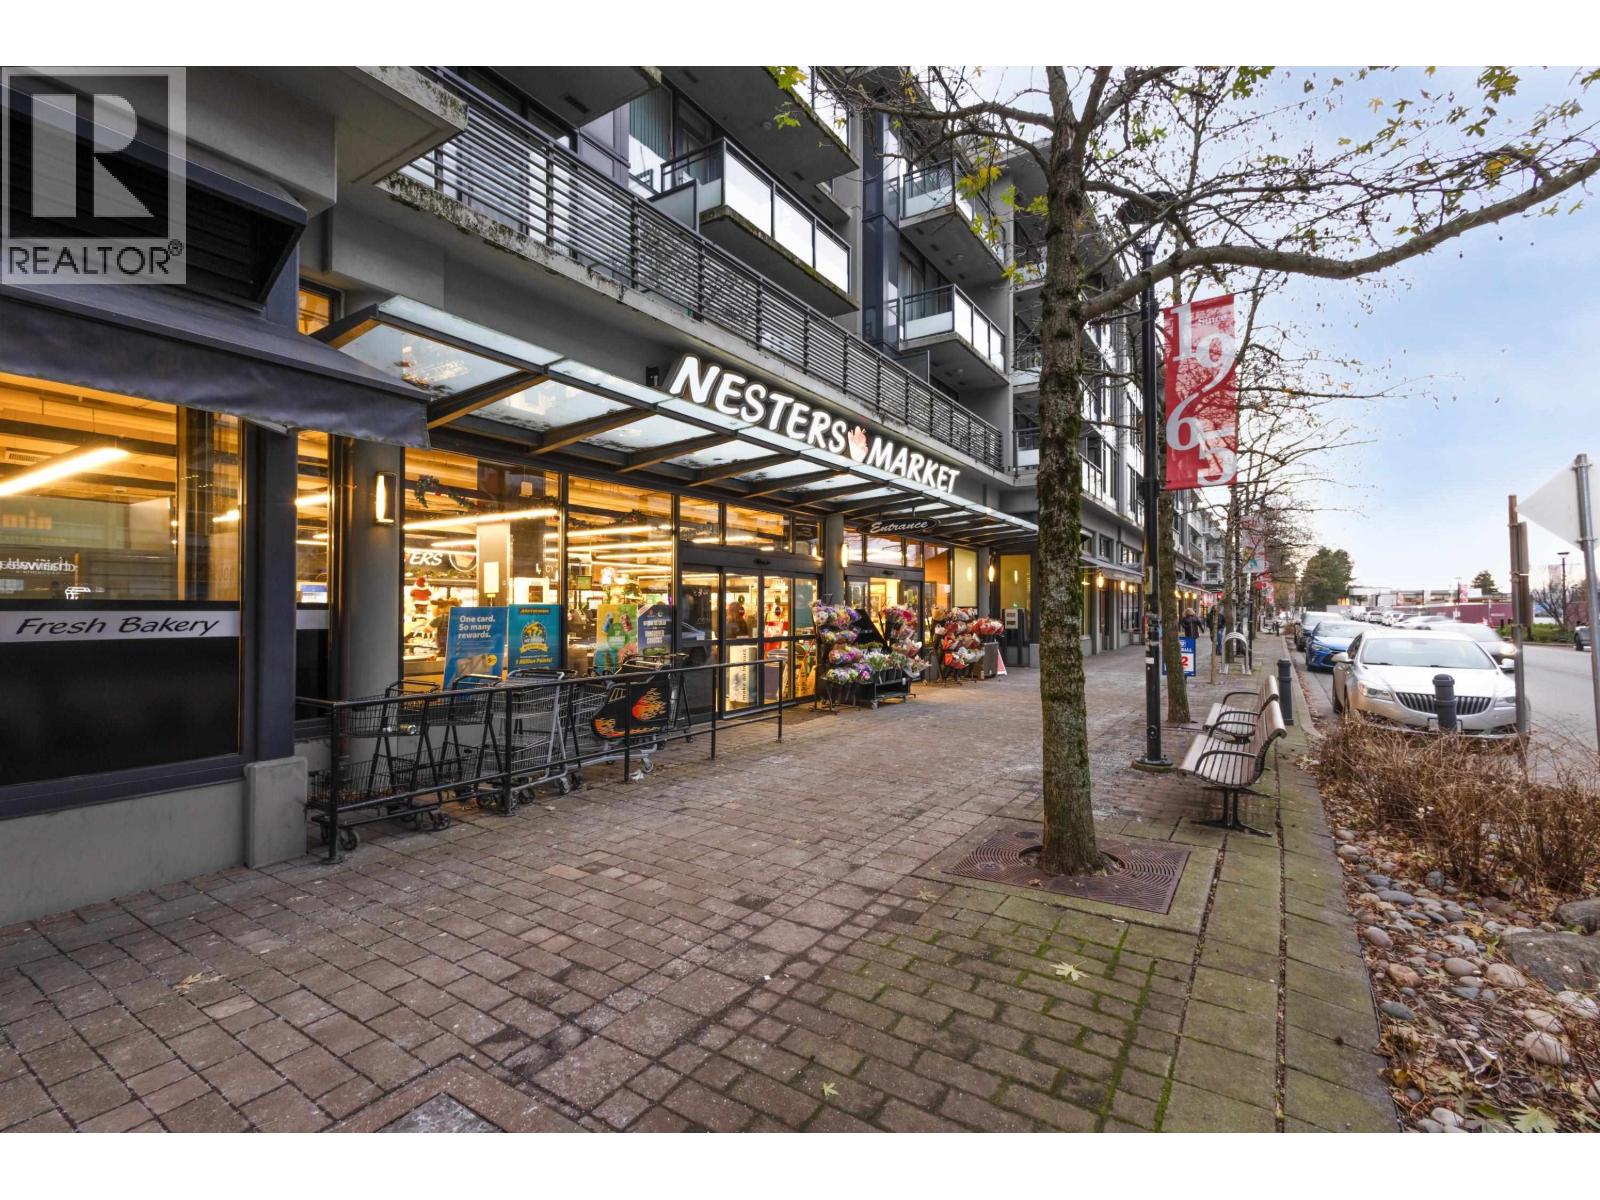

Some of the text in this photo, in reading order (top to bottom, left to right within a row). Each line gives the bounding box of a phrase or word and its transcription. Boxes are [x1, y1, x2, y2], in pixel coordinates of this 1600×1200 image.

[669, 355, 960, 494] NESTERS MARKET
[869, 521, 929, 534] Entrance
[459, 615, 496, 623] One card.
[16, 615, 220, 638] Fresh Bakery
[458, 623, 491, 632] So many
[458, 631, 491, 639] rewards.
